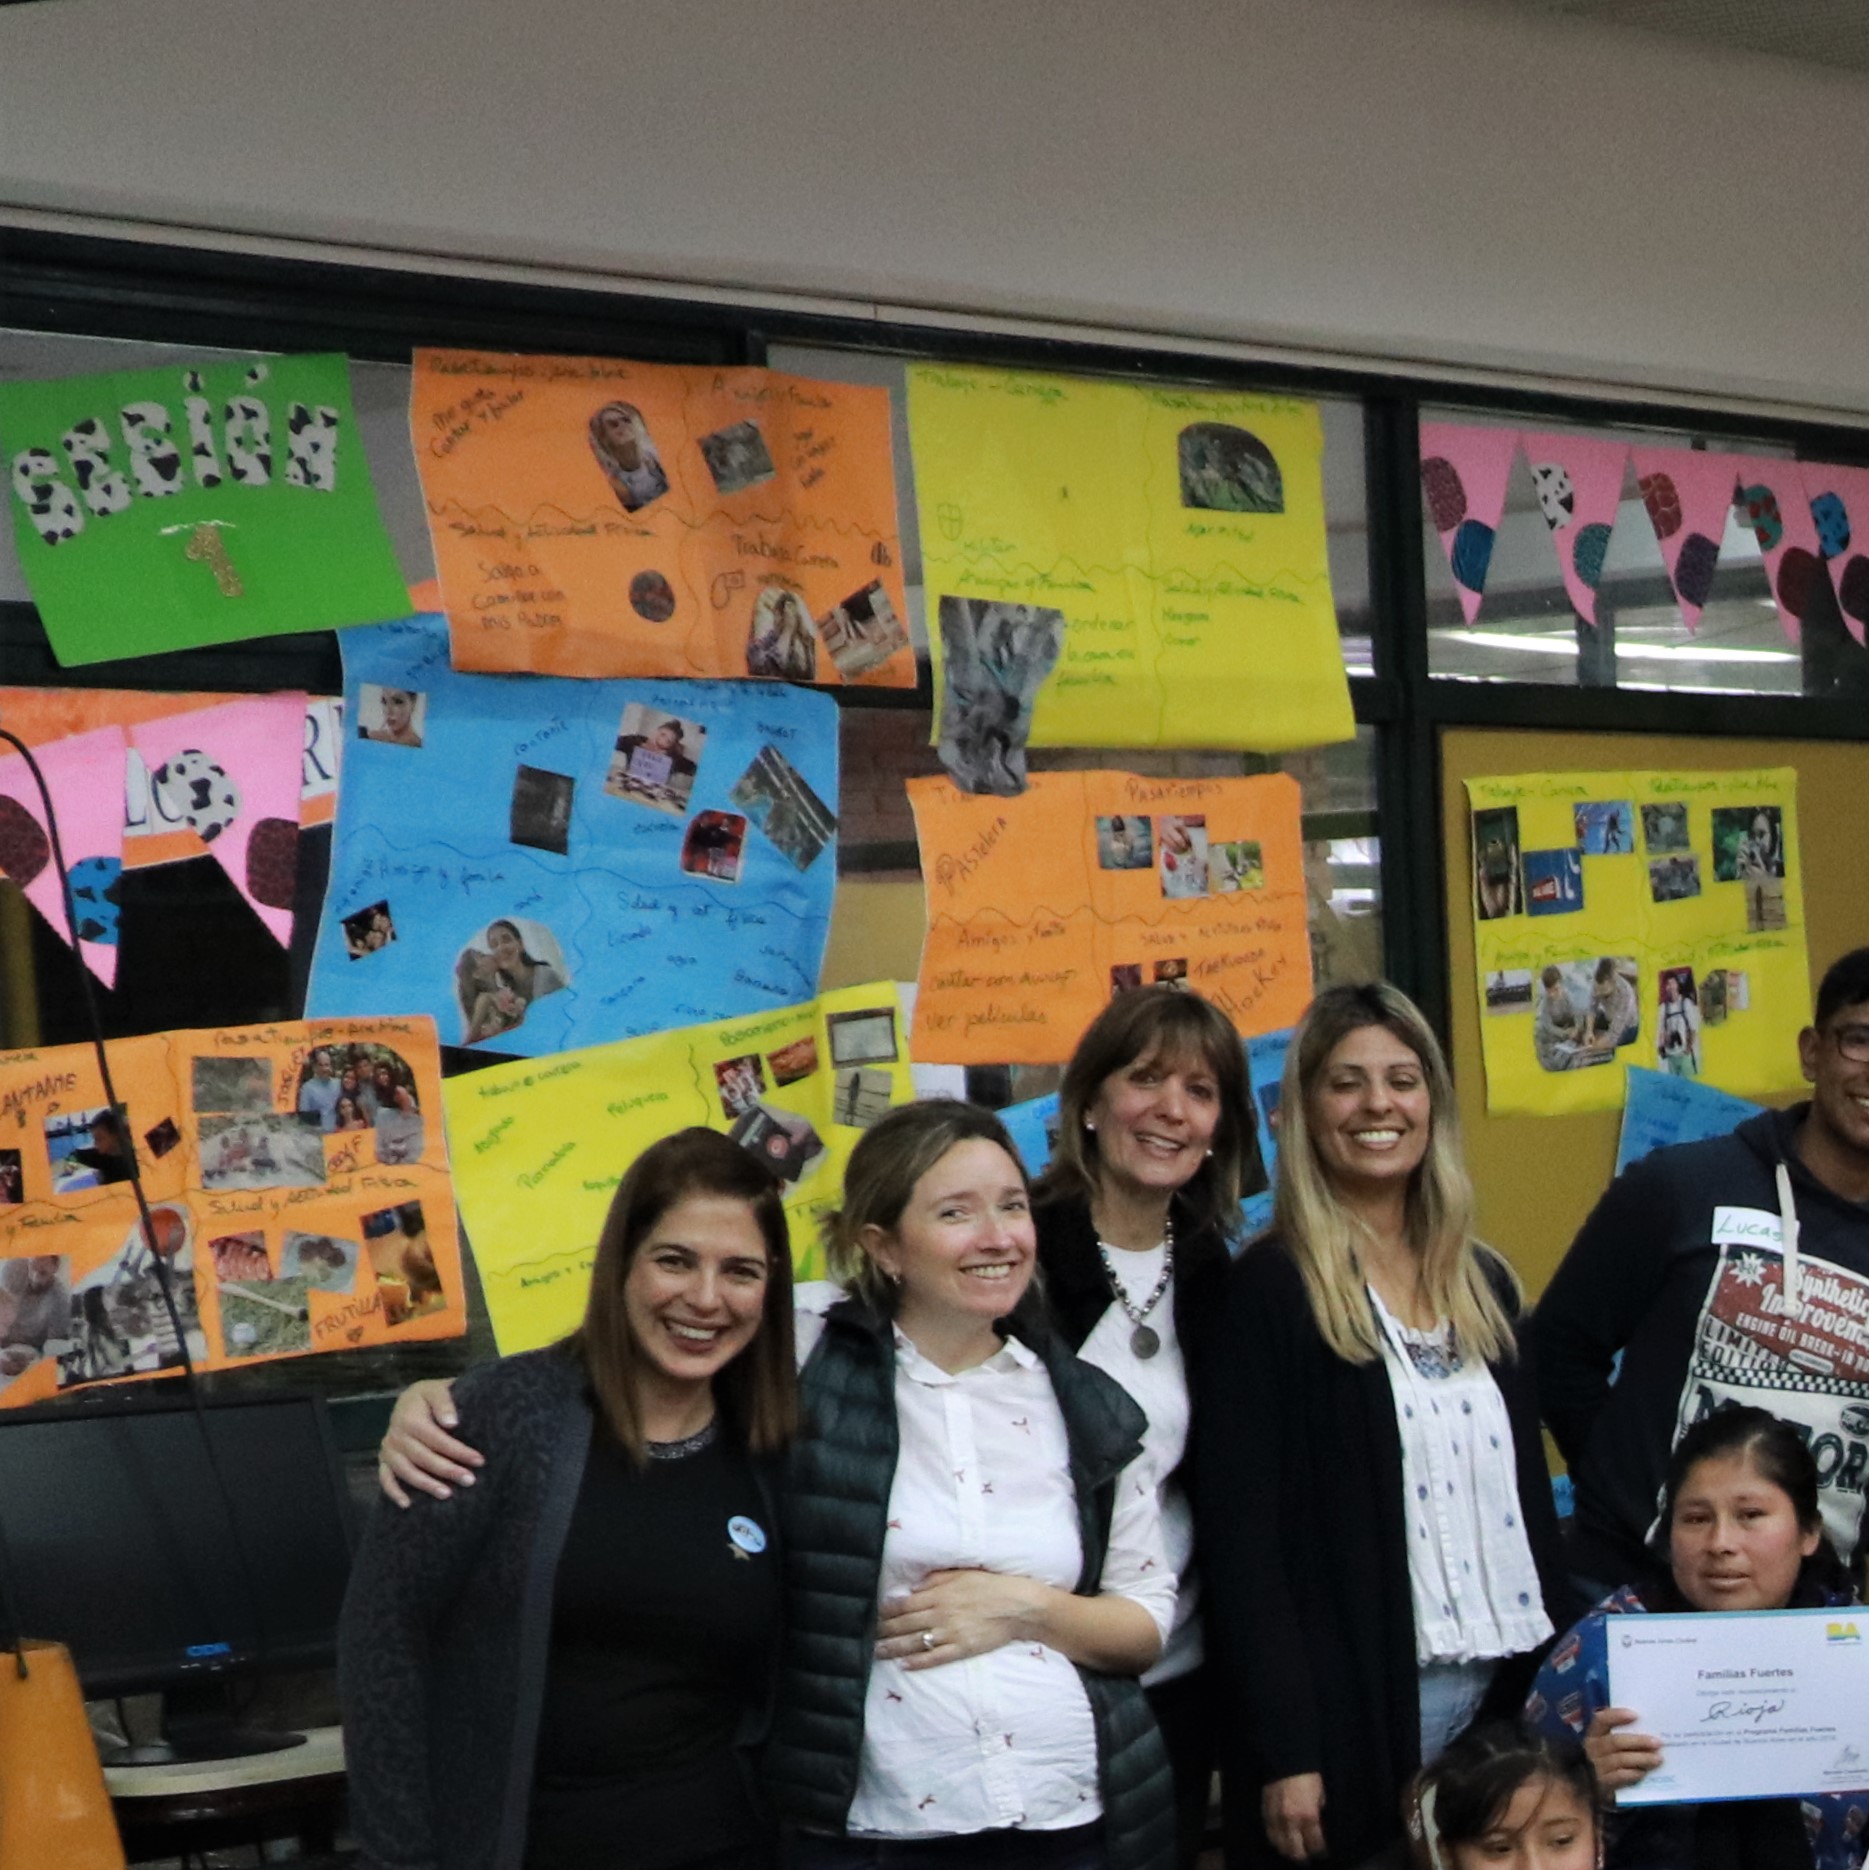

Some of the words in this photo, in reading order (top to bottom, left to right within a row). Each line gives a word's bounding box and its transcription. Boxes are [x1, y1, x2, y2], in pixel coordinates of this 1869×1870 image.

[11, 363, 339, 547] SESIÓN
[184, 524, 244, 598] 1
[1697, 1668, 1746, 1680] Familias
[1749, 1667, 1794, 1679] Fuertes
[1700, 1699, 1785, 1724] Rioja
